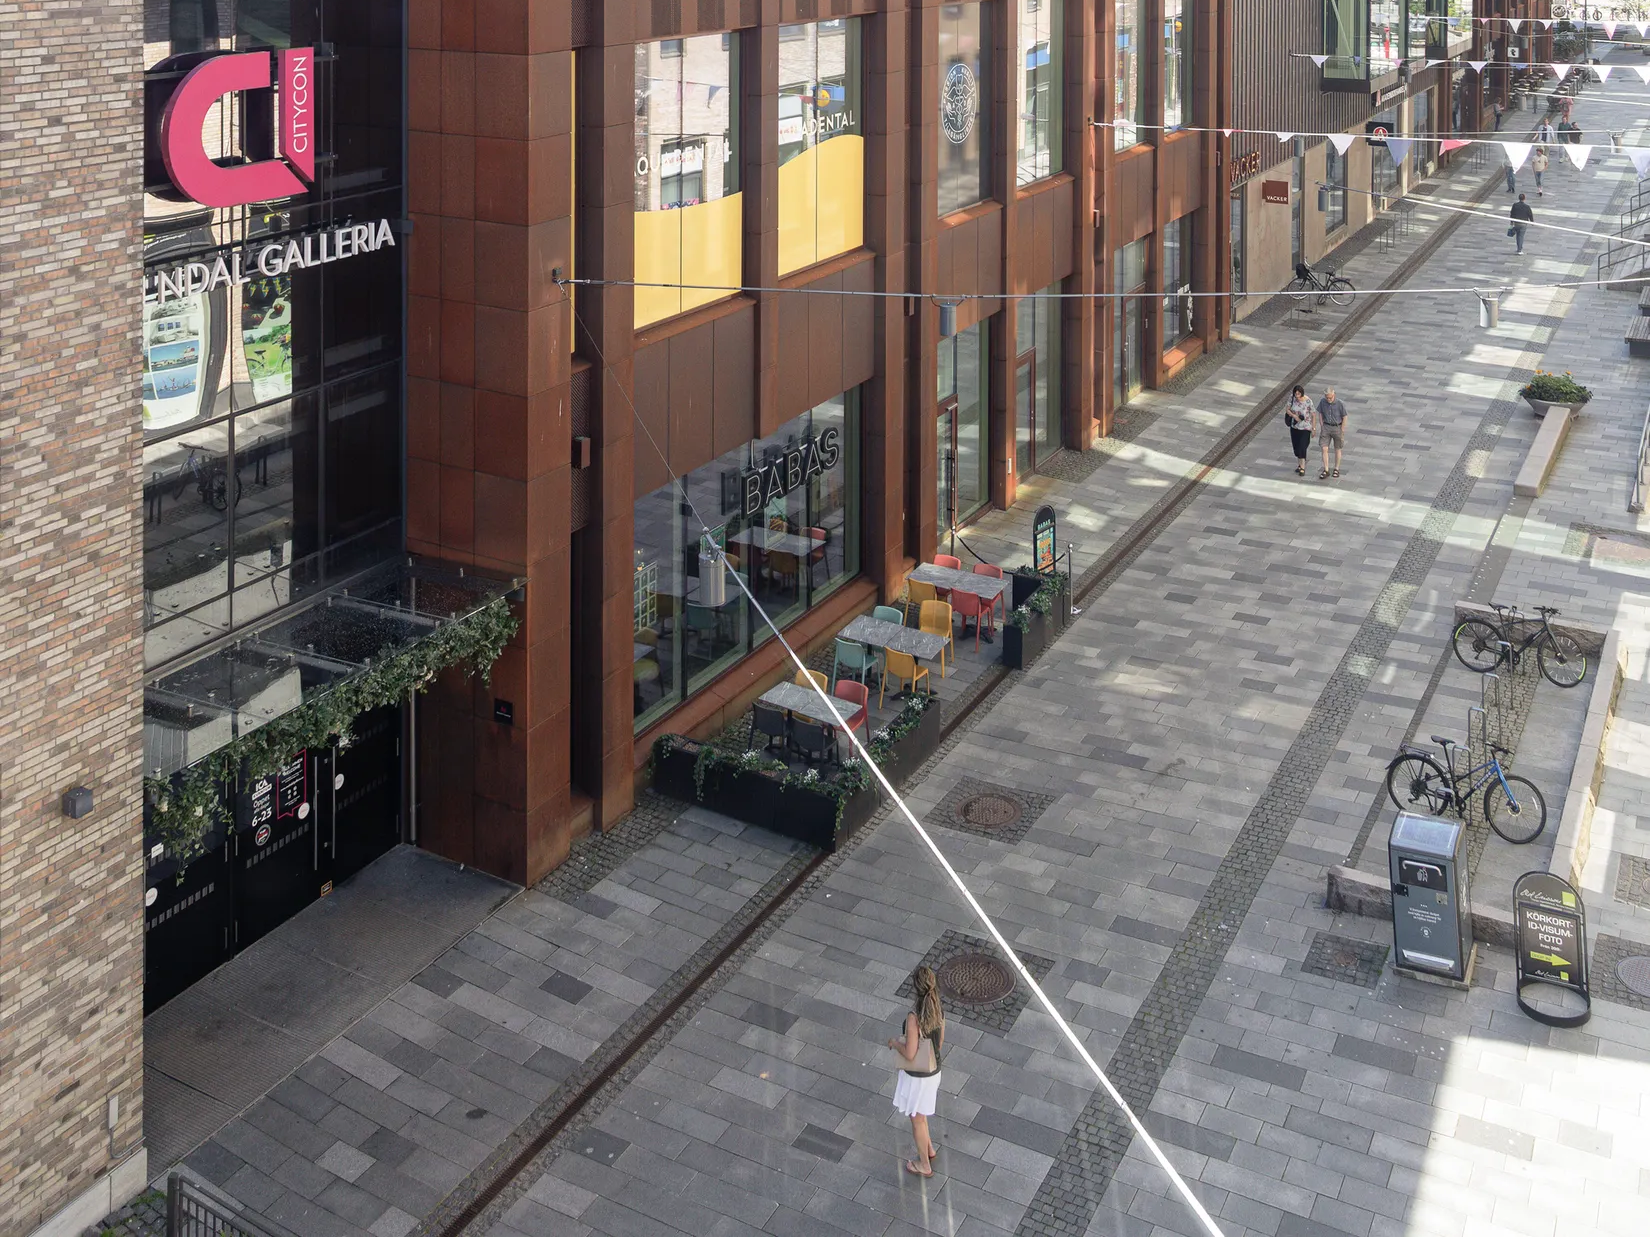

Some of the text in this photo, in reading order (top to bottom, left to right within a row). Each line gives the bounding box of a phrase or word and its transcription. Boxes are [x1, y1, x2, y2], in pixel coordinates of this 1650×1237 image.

[293, 56, 308, 153] CITYCON
[1230, 151, 1260, 183] VACKER
[142, 218, 396, 305] NDAL GALLERIA
[740, 426, 840, 520] BABAS
[255, 779, 268, 792] ICA
[252, 806, 272, 827] 6-23
[1528, 920, 1573, 938] ID-VISUM-
[1539, 933, 1563, 945] FOTO
